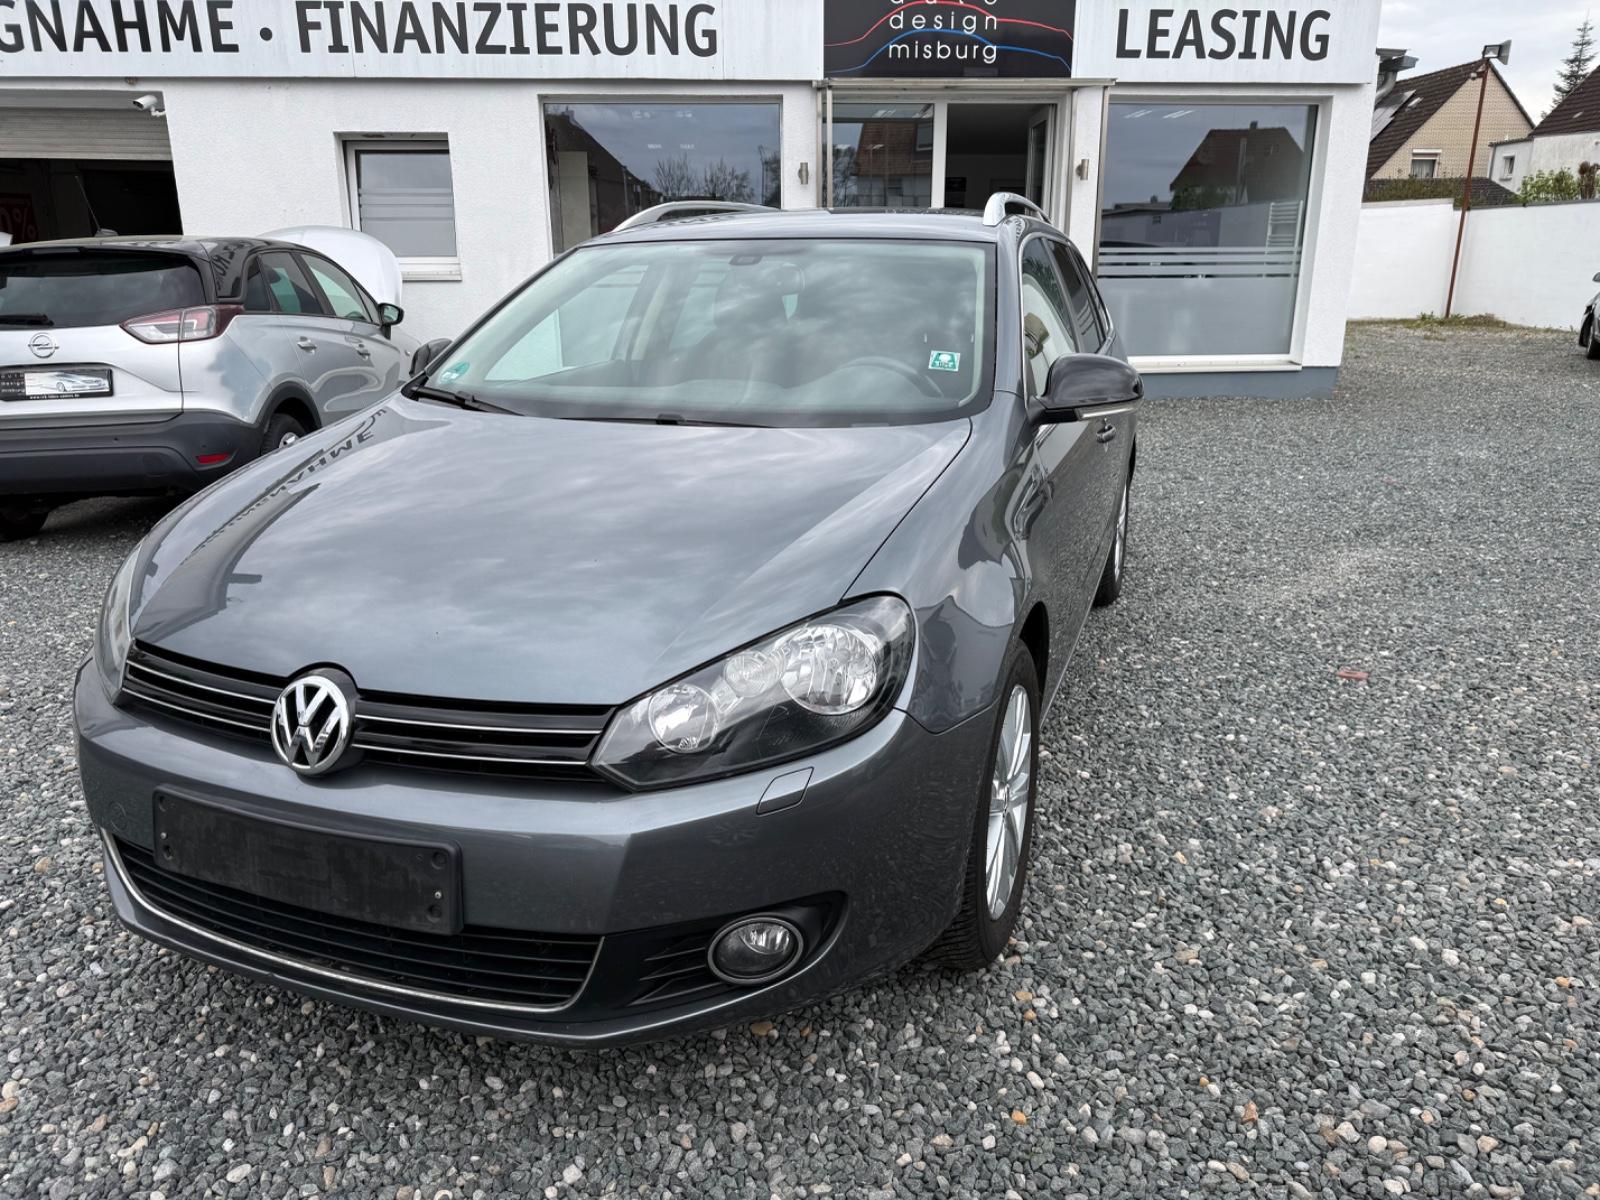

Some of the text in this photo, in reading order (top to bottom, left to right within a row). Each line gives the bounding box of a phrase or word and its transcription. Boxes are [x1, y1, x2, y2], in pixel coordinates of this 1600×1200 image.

[295, 0, 717, 57] FINANZIERUNG
[889, 10, 997, 34] design
[1116, 9, 1331, 61] LEASING
[889, 40, 997, 64] misburg
